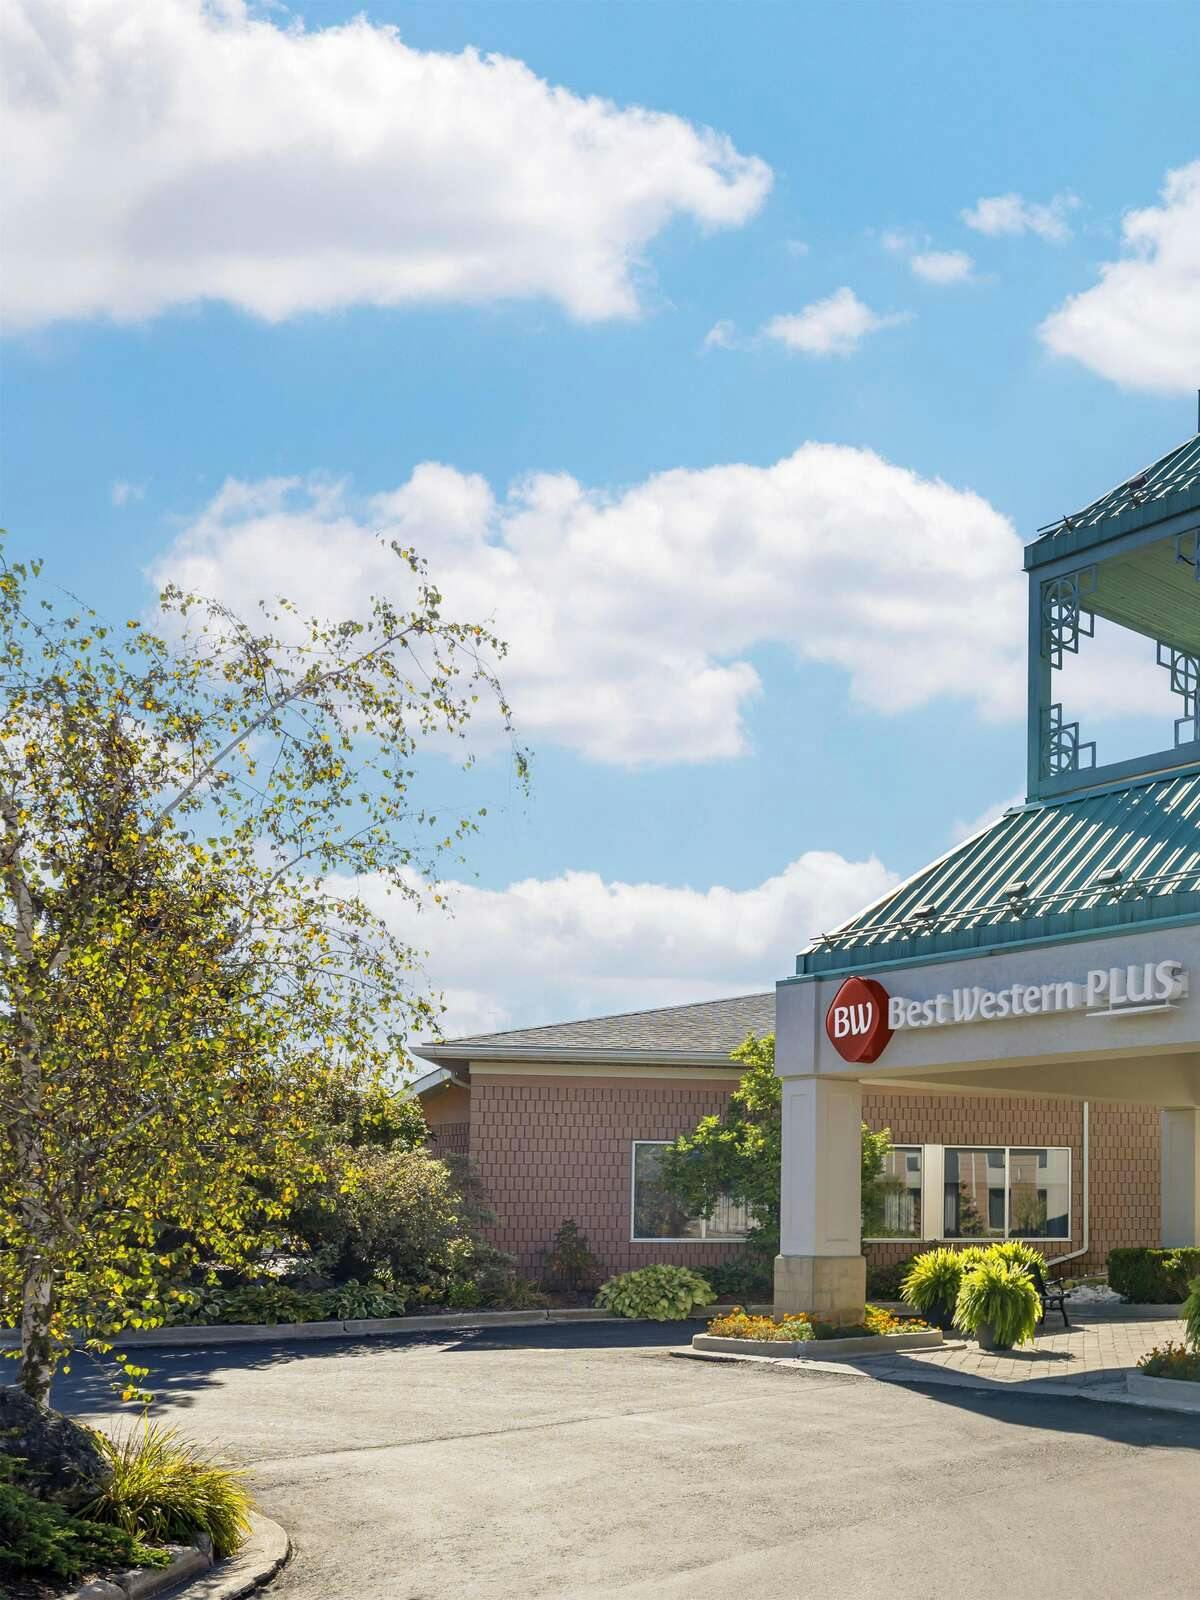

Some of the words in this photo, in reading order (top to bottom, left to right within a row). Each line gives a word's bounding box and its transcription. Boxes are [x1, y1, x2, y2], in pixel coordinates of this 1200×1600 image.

[834, 1002, 873, 1038] BW
[887, 993, 947, 1030] Best
[952, 981, 1075, 1022] Western
[1087, 959, 1184, 1007] PLUS
